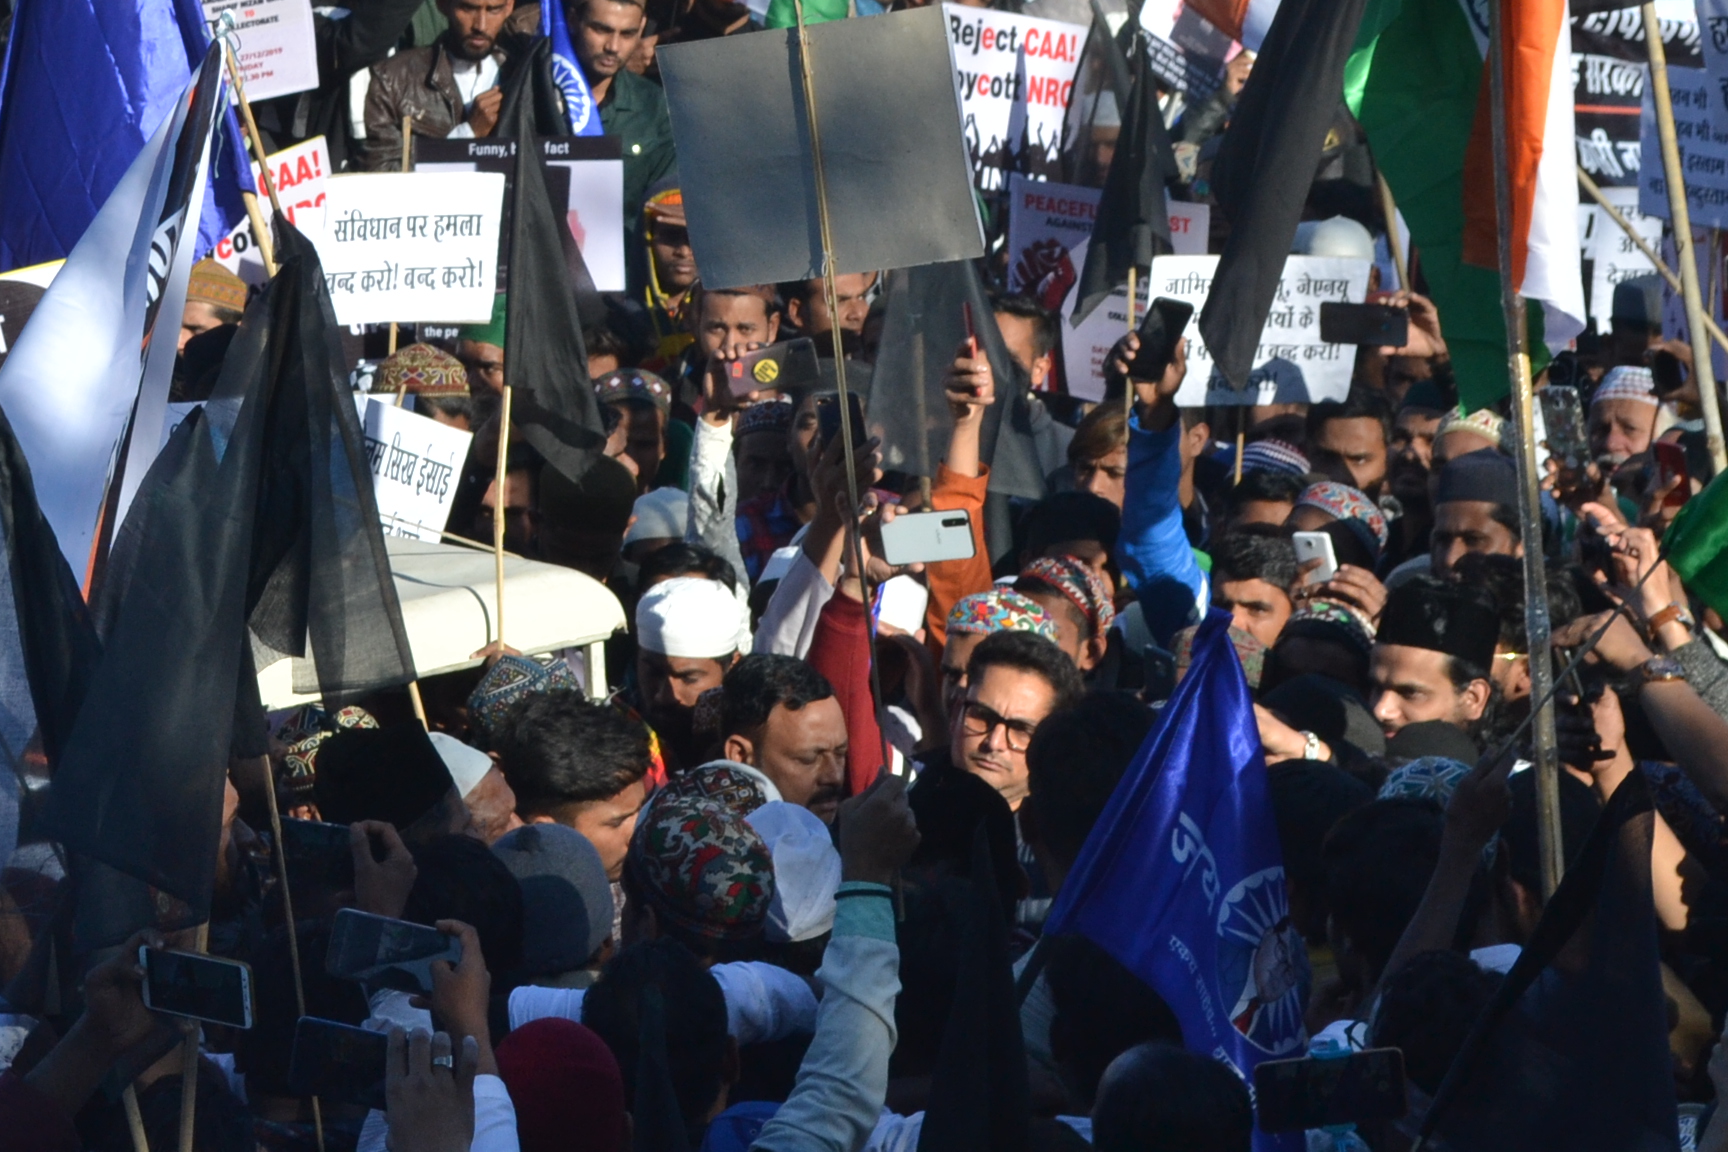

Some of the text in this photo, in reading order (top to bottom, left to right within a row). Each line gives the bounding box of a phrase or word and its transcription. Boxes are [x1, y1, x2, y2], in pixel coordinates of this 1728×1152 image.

[949, 13, 1078, 64] Reject CAA!
[468, 142, 509, 158] Funny,
[544, 140, 571, 156] fact
[333, 208, 404, 243] संविधान
[406, 215, 429, 239] पर
[433, 213, 484, 244] हमला
[424, 326, 443, 339] the
[384, 431, 420, 487] सिख
